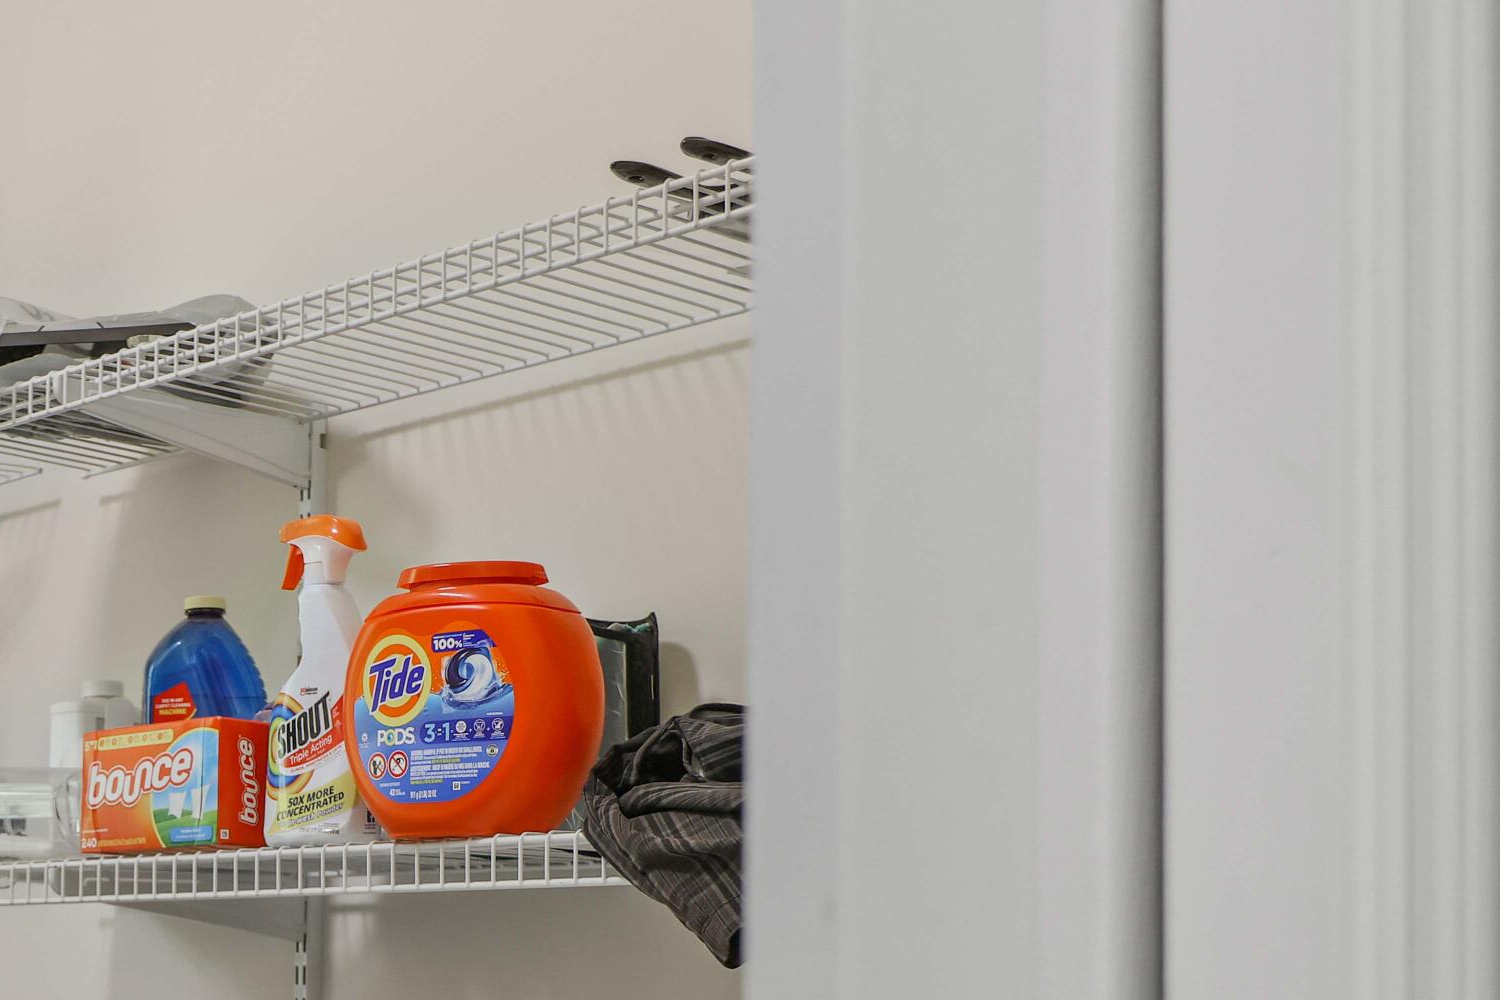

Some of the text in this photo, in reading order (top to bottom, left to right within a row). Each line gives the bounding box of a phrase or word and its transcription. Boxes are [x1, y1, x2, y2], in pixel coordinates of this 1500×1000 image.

[433, 637, 463, 651] 100%
[369, 653, 426, 715] Tide
[277, 690, 331, 760] SHOUT
[377, 726, 415, 747] PODS
[290, 749, 309, 765] Triple
[310, 735, 333, 754] Acting
[87, 747, 193, 809] bounce
[238, 738, 259, 826] bounce
[276, 791, 345, 821] CONCENTRATED
[287, 785, 335, 809] 50X MORE
[82, 837, 97, 849] 240
